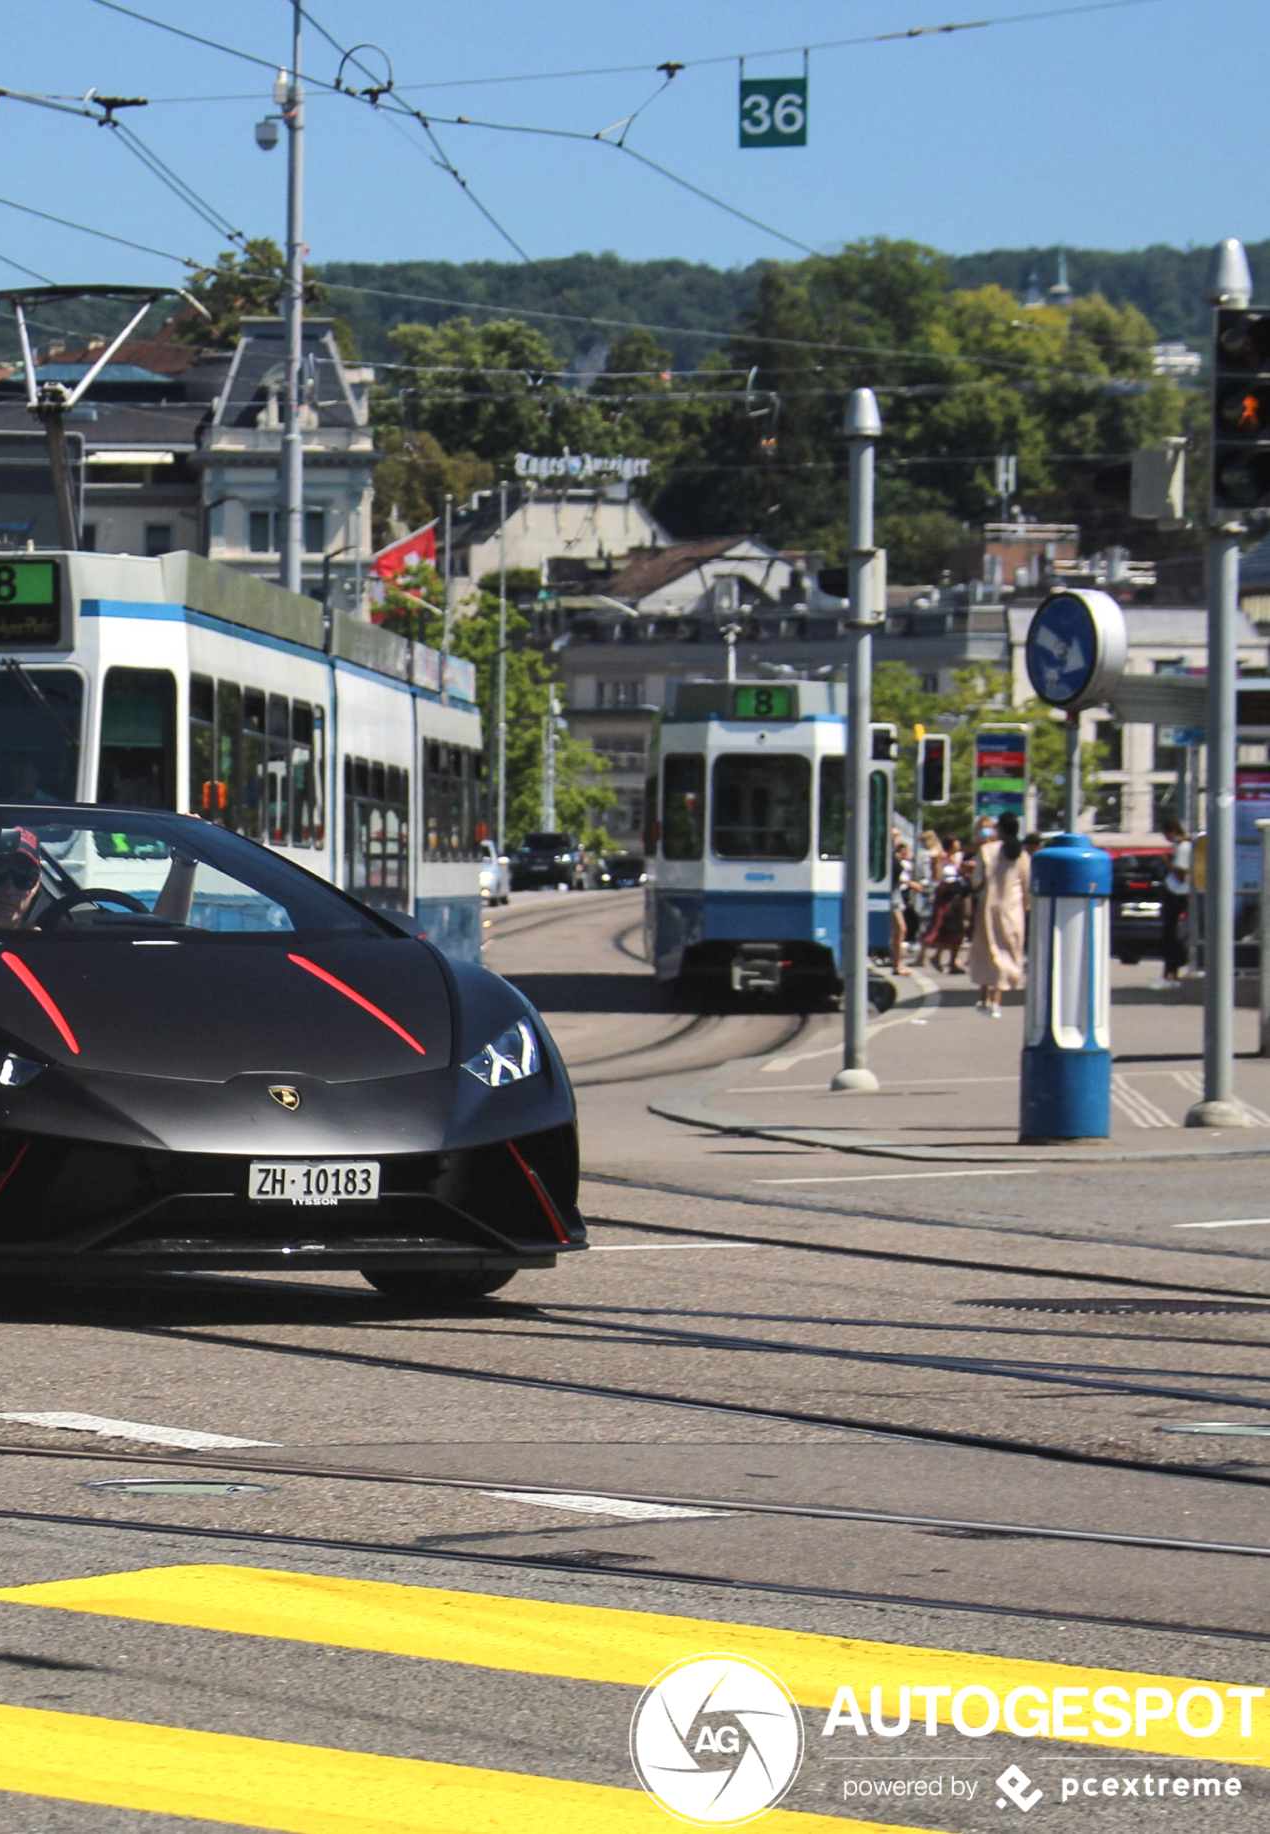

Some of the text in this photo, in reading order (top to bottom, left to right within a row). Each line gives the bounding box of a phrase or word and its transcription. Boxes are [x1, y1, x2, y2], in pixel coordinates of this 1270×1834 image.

[742, 93, 805, 135] 36
[514, 452, 651, 481] Tages Anzeiger
[755, 690, 773, 715] 8
